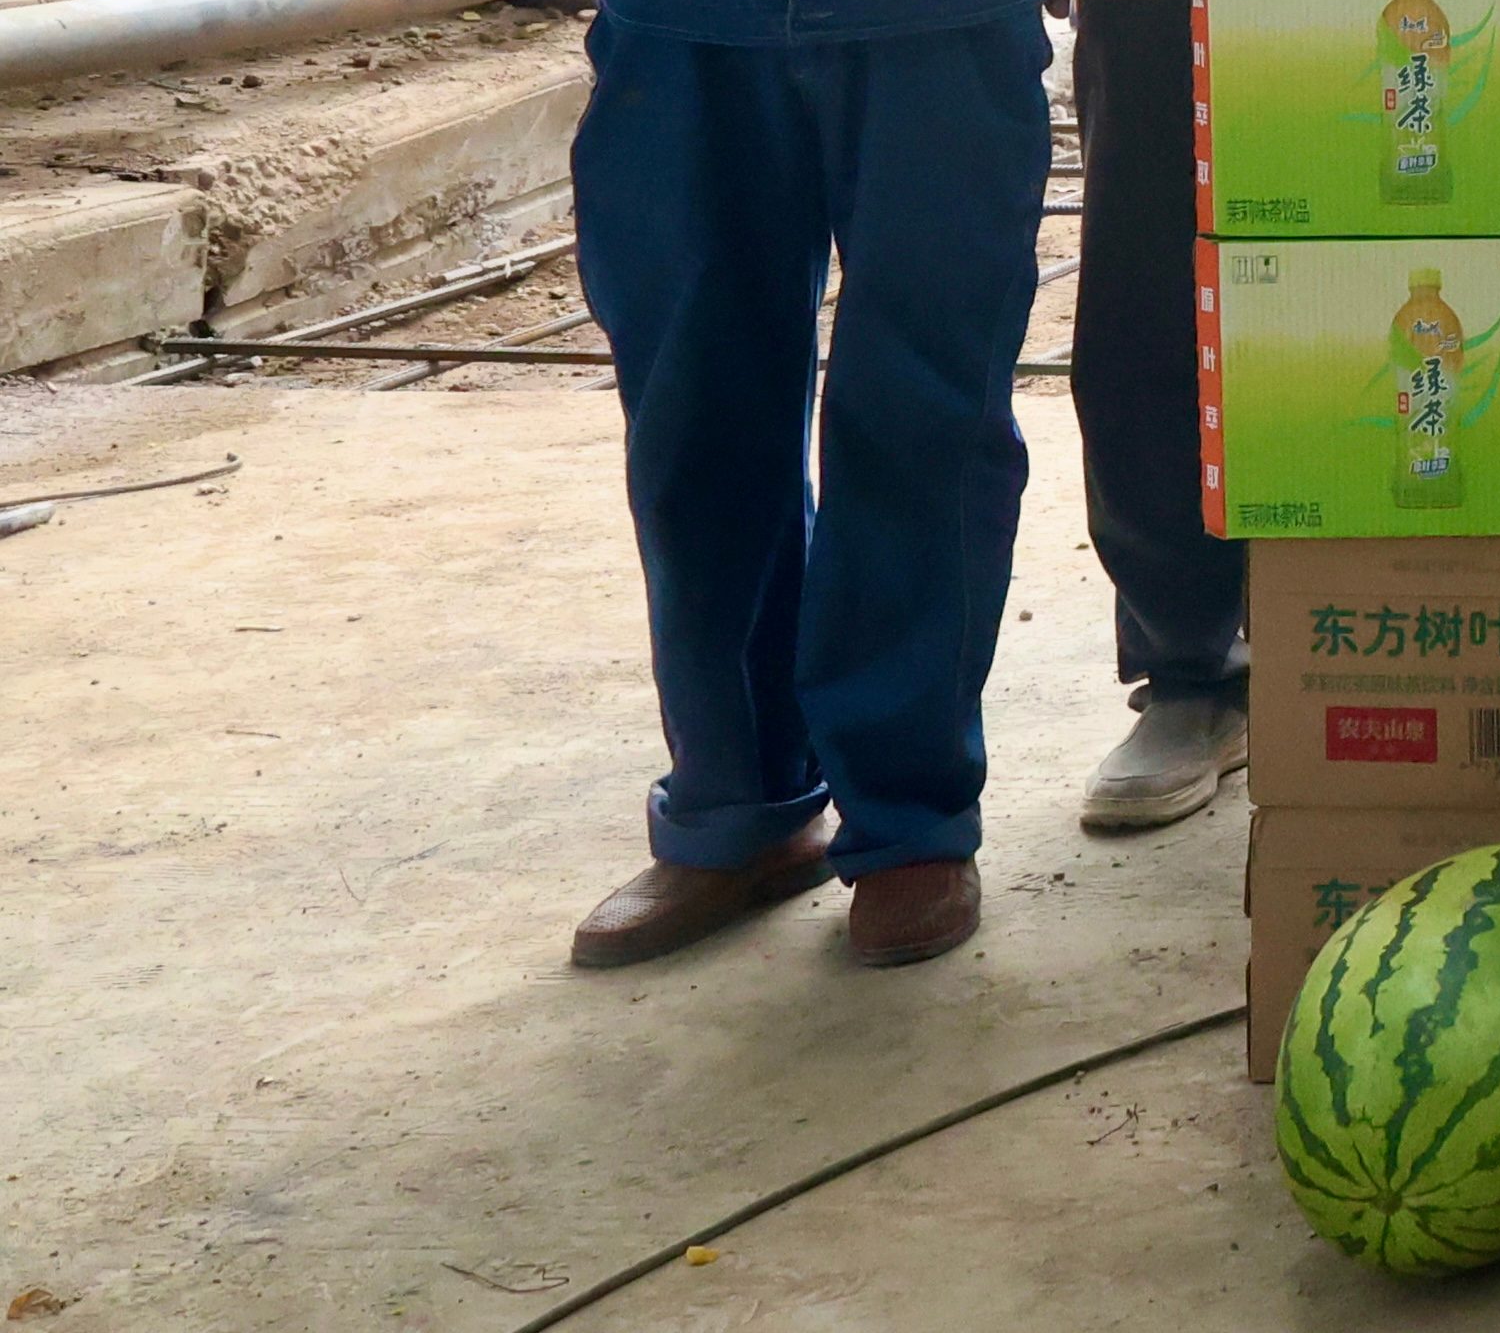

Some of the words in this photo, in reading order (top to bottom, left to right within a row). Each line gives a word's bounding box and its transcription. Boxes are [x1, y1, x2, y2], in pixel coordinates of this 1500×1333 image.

[1398, 53, 1434, 133] 绿茶
[1411, 358, 1447, 435] 绿茶
[1338, 716, 1426, 741] 农夫山泉
